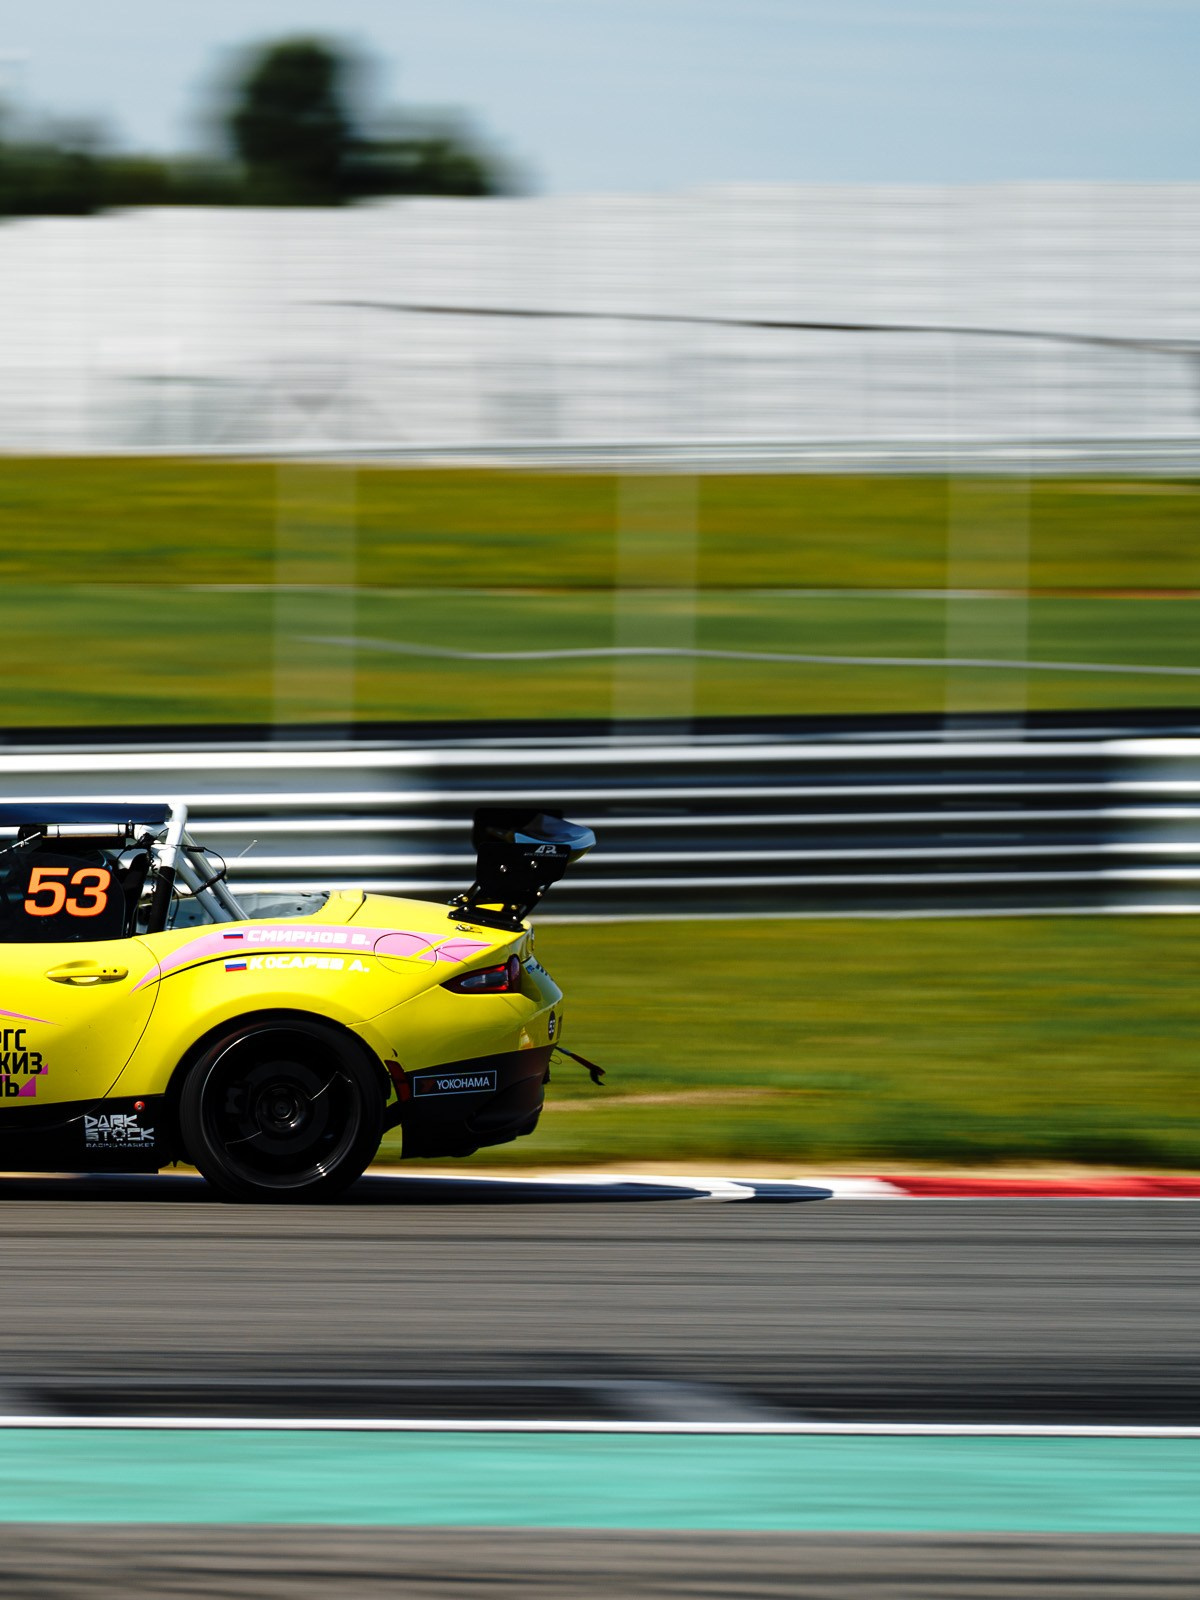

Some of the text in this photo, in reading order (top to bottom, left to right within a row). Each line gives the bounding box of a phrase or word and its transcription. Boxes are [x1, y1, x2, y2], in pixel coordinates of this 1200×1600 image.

[24, 867, 111, 917] 53
[247, 930, 347, 944] СМИРНОВ
[436, 1077, 490, 1090] YOKOHAMA
[84, 1114, 138, 1128] DARK
[85, 1127, 155, 1141] STOCK
